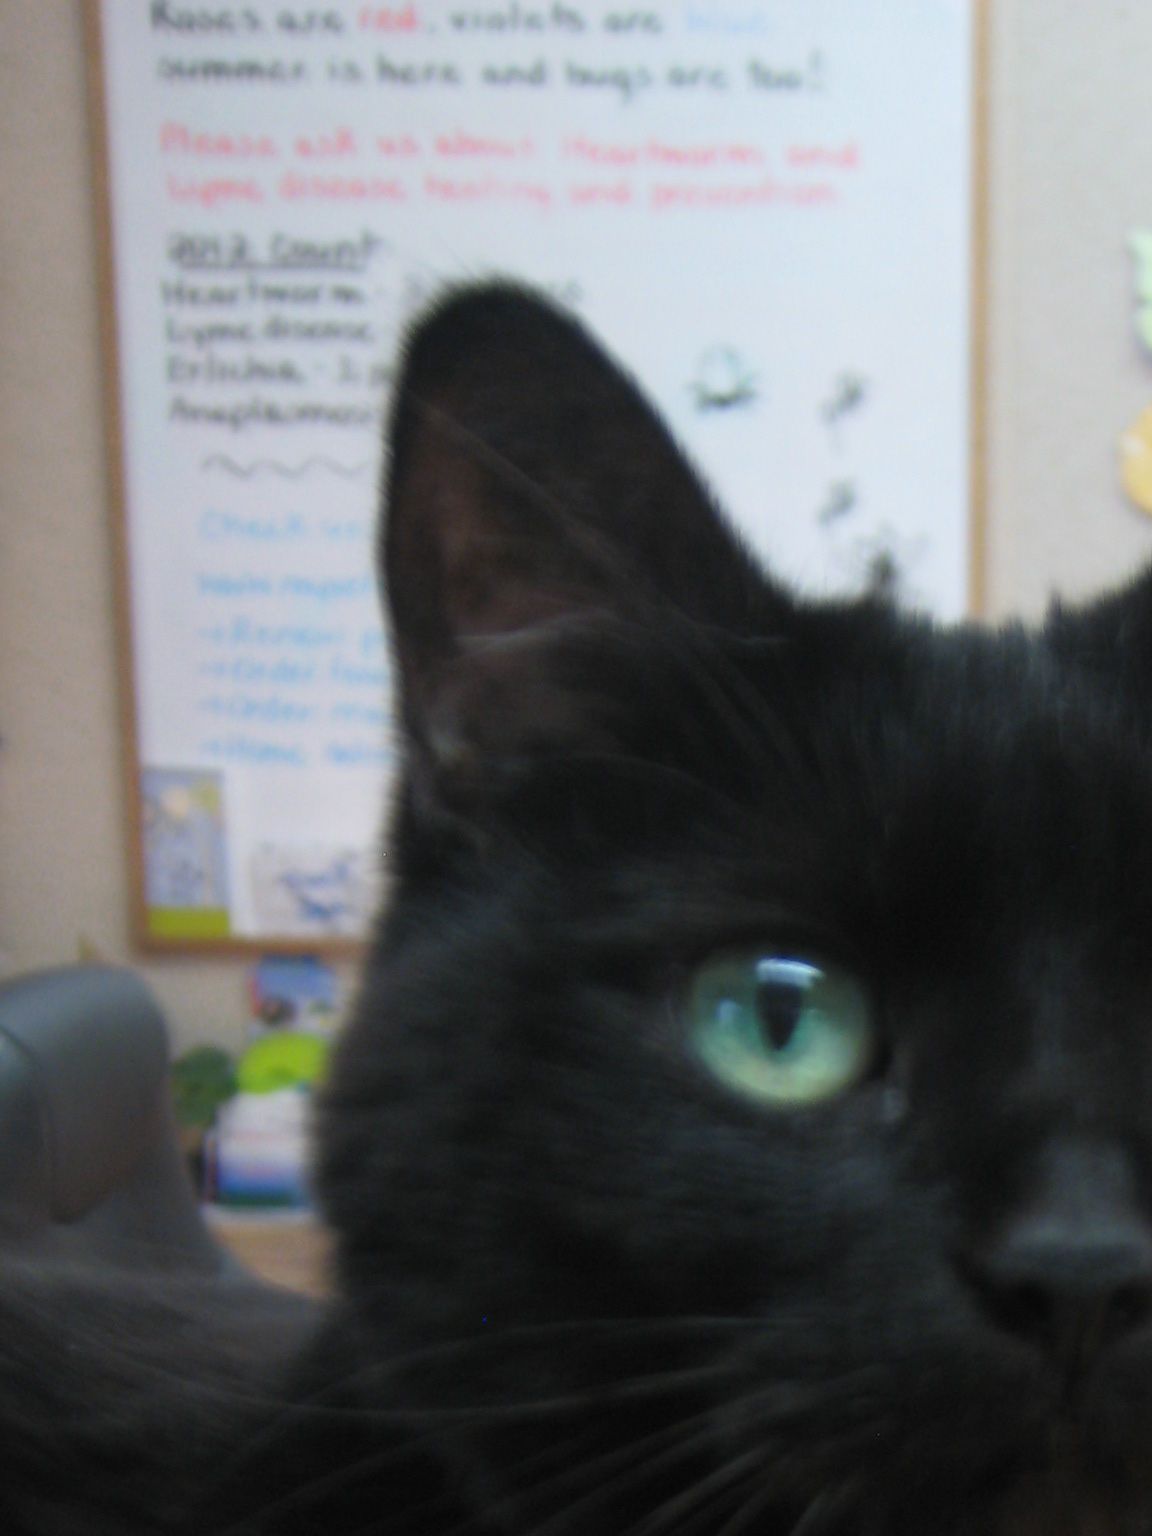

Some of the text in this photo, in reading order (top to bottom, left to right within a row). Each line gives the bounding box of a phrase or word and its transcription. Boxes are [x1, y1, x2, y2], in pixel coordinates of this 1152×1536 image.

[276, 9, 345, 33] are
[602, 11, 663, 34] are
[326, 58, 363, 82] is
[376, 51, 461, 84] here
[481, 57, 548, 86] and
[565, 58, 653, 104] bugs
[667, 66, 728, 88] are
[160, 120, 279, 157] Please
[294, 124, 356, 156] ask
[376, 132, 419, 155] us
[435, 128, 534, 158] about
[786, 130, 860, 168] and
[167, 171, 266, 207] Lyme
[569, 179, 633, 206] and
